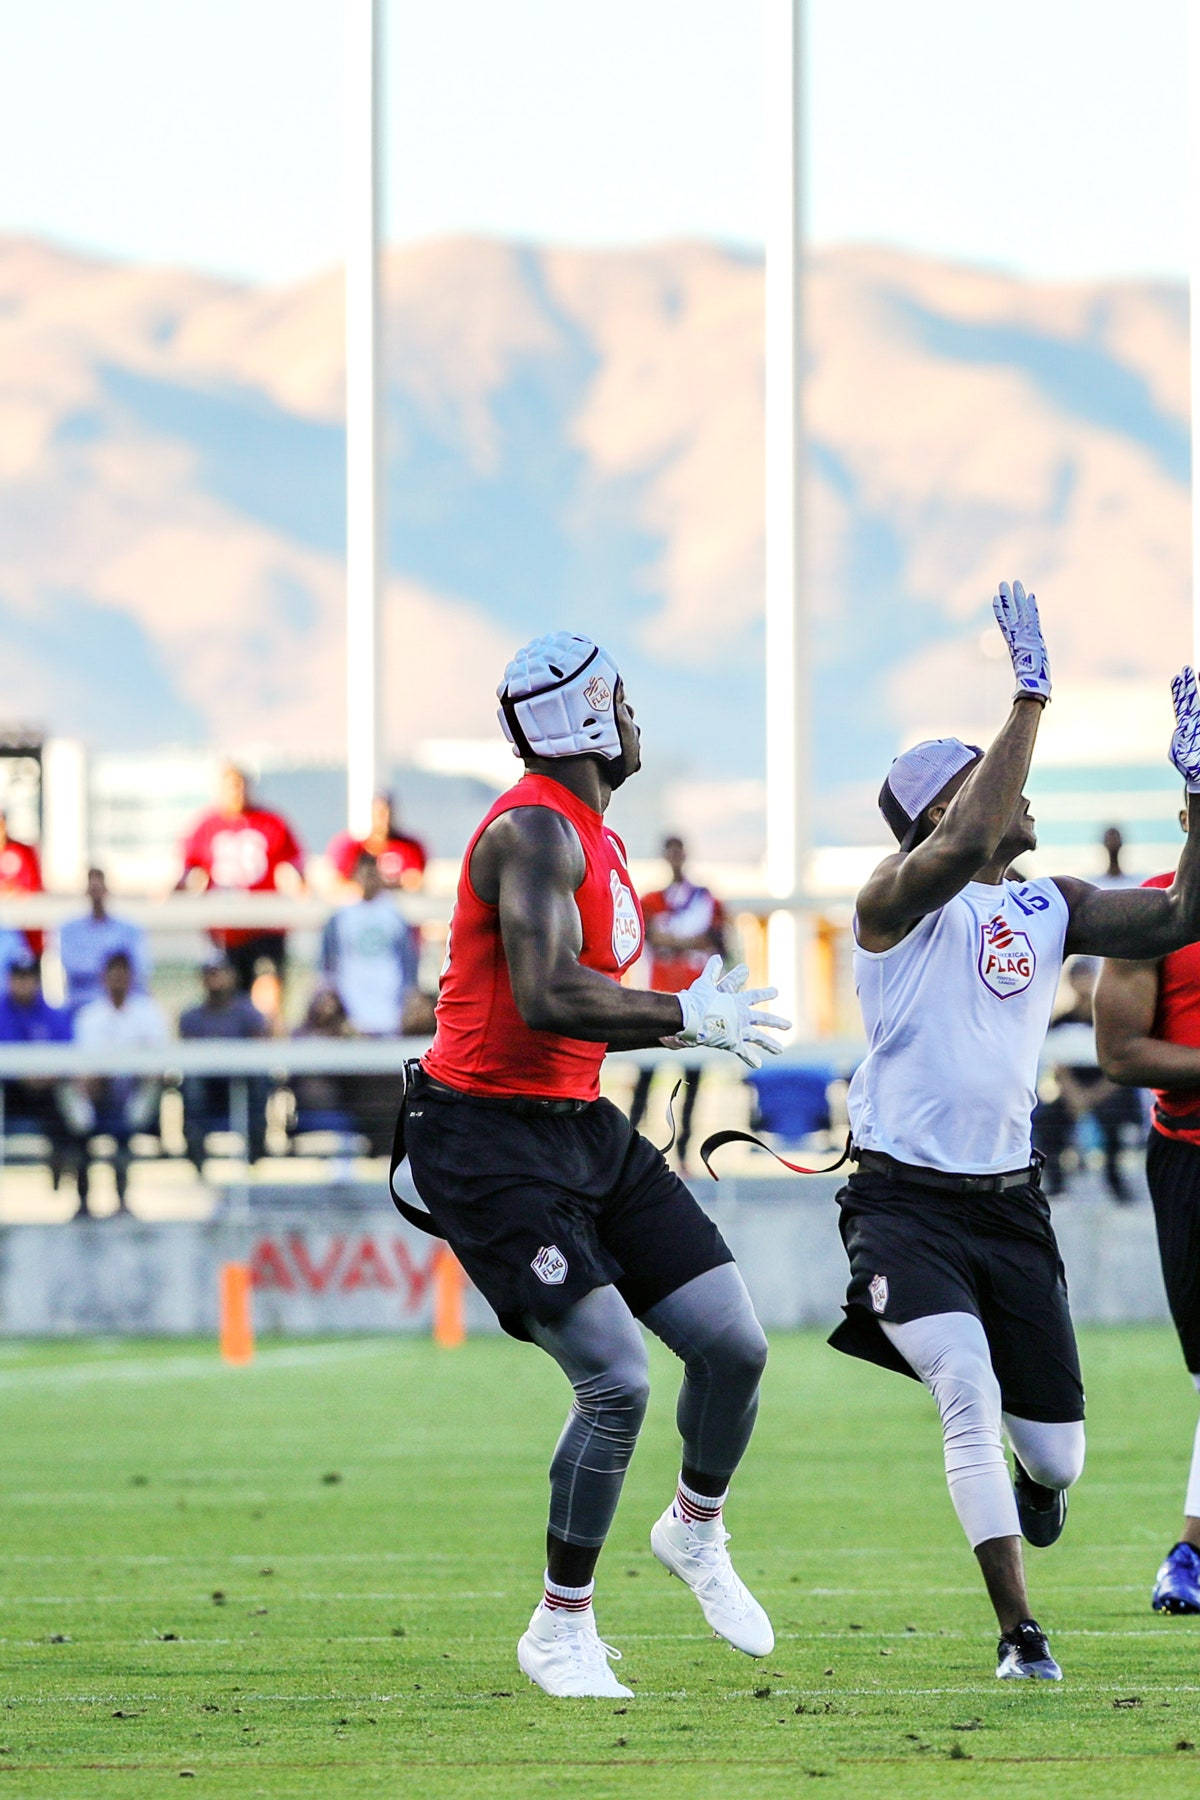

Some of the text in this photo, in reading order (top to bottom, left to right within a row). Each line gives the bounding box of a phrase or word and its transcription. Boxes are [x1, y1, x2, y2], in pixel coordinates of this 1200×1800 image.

[591, 689, 610, 708] FLAG
[615, 917, 637, 940] FLAG
[985, 954, 1030, 977] FLAG
[250, 1232, 460, 1312] AVAY
[542, 1259, 564, 1280] FLAG
